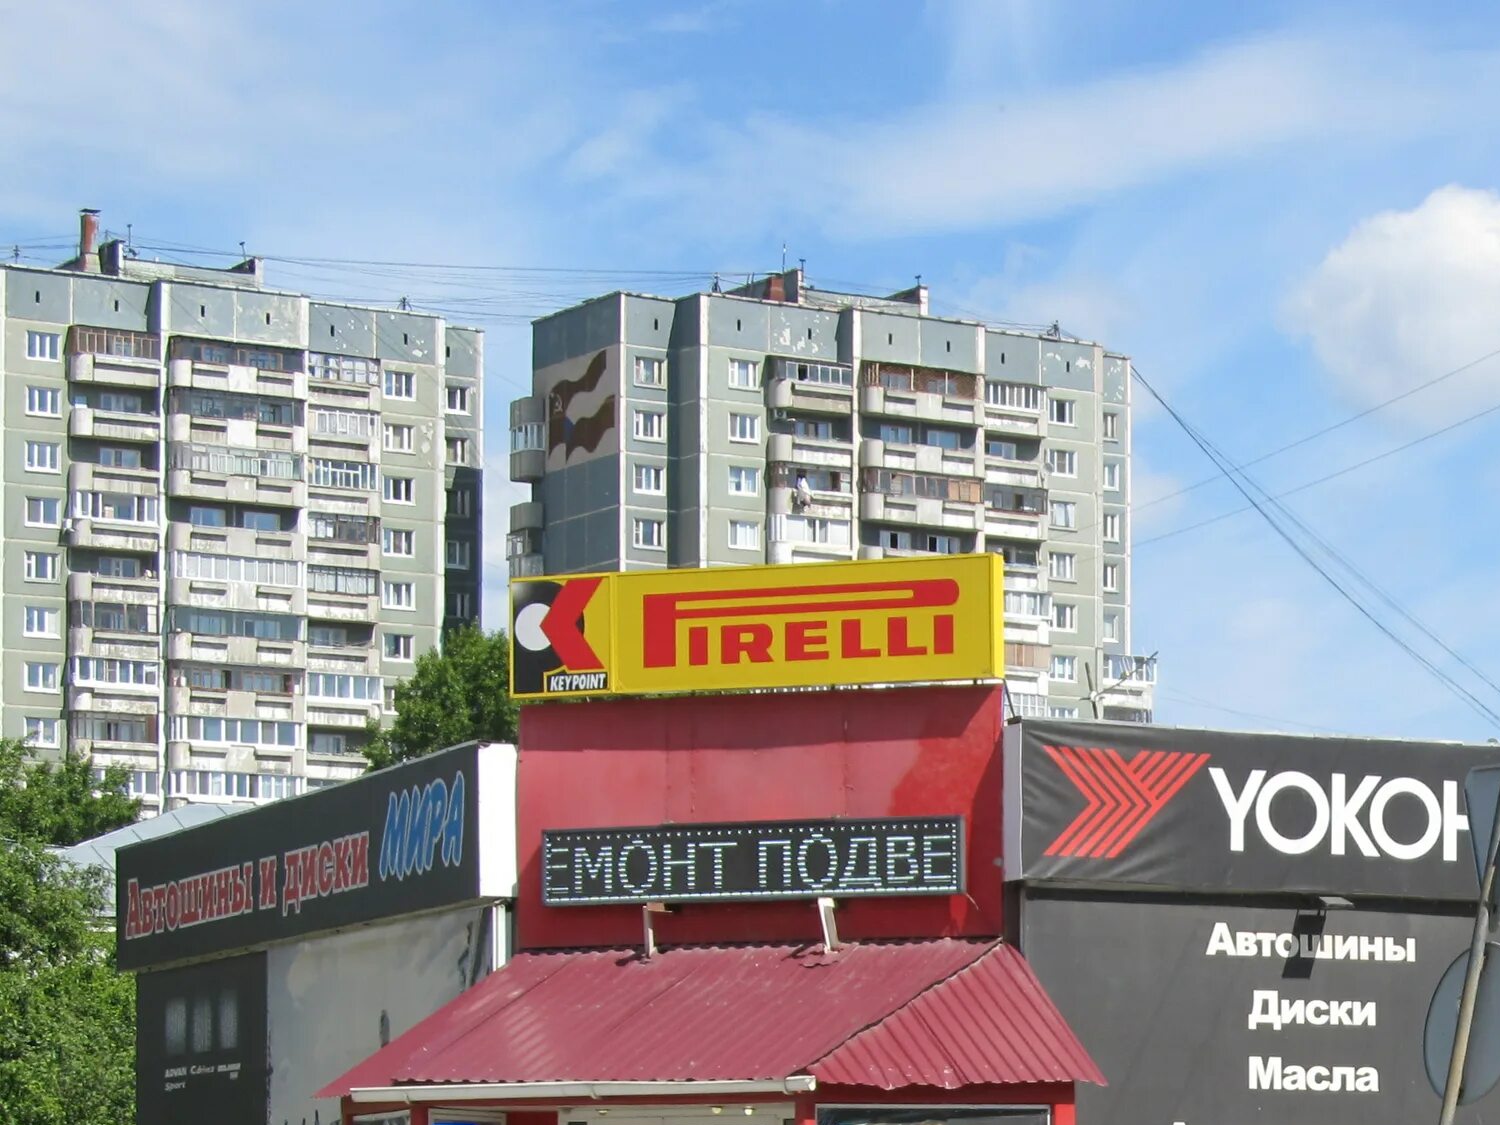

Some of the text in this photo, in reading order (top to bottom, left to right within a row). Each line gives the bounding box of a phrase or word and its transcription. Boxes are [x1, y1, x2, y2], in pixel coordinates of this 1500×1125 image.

[643, 578, 960, 669] PIRELLI
[549, 673, 607, 692] KEYPOINT
[126, 861, 253, 940] Автошины
[379, 770, 465, 881] МИРА
[758, 834, 952, 888] ПОДВЕ
[1206, 922, 1417, 962] Автошины
[1248, 990, 1377, 1030] Диски
[1248, 1056, 1379, 1093] Масла
